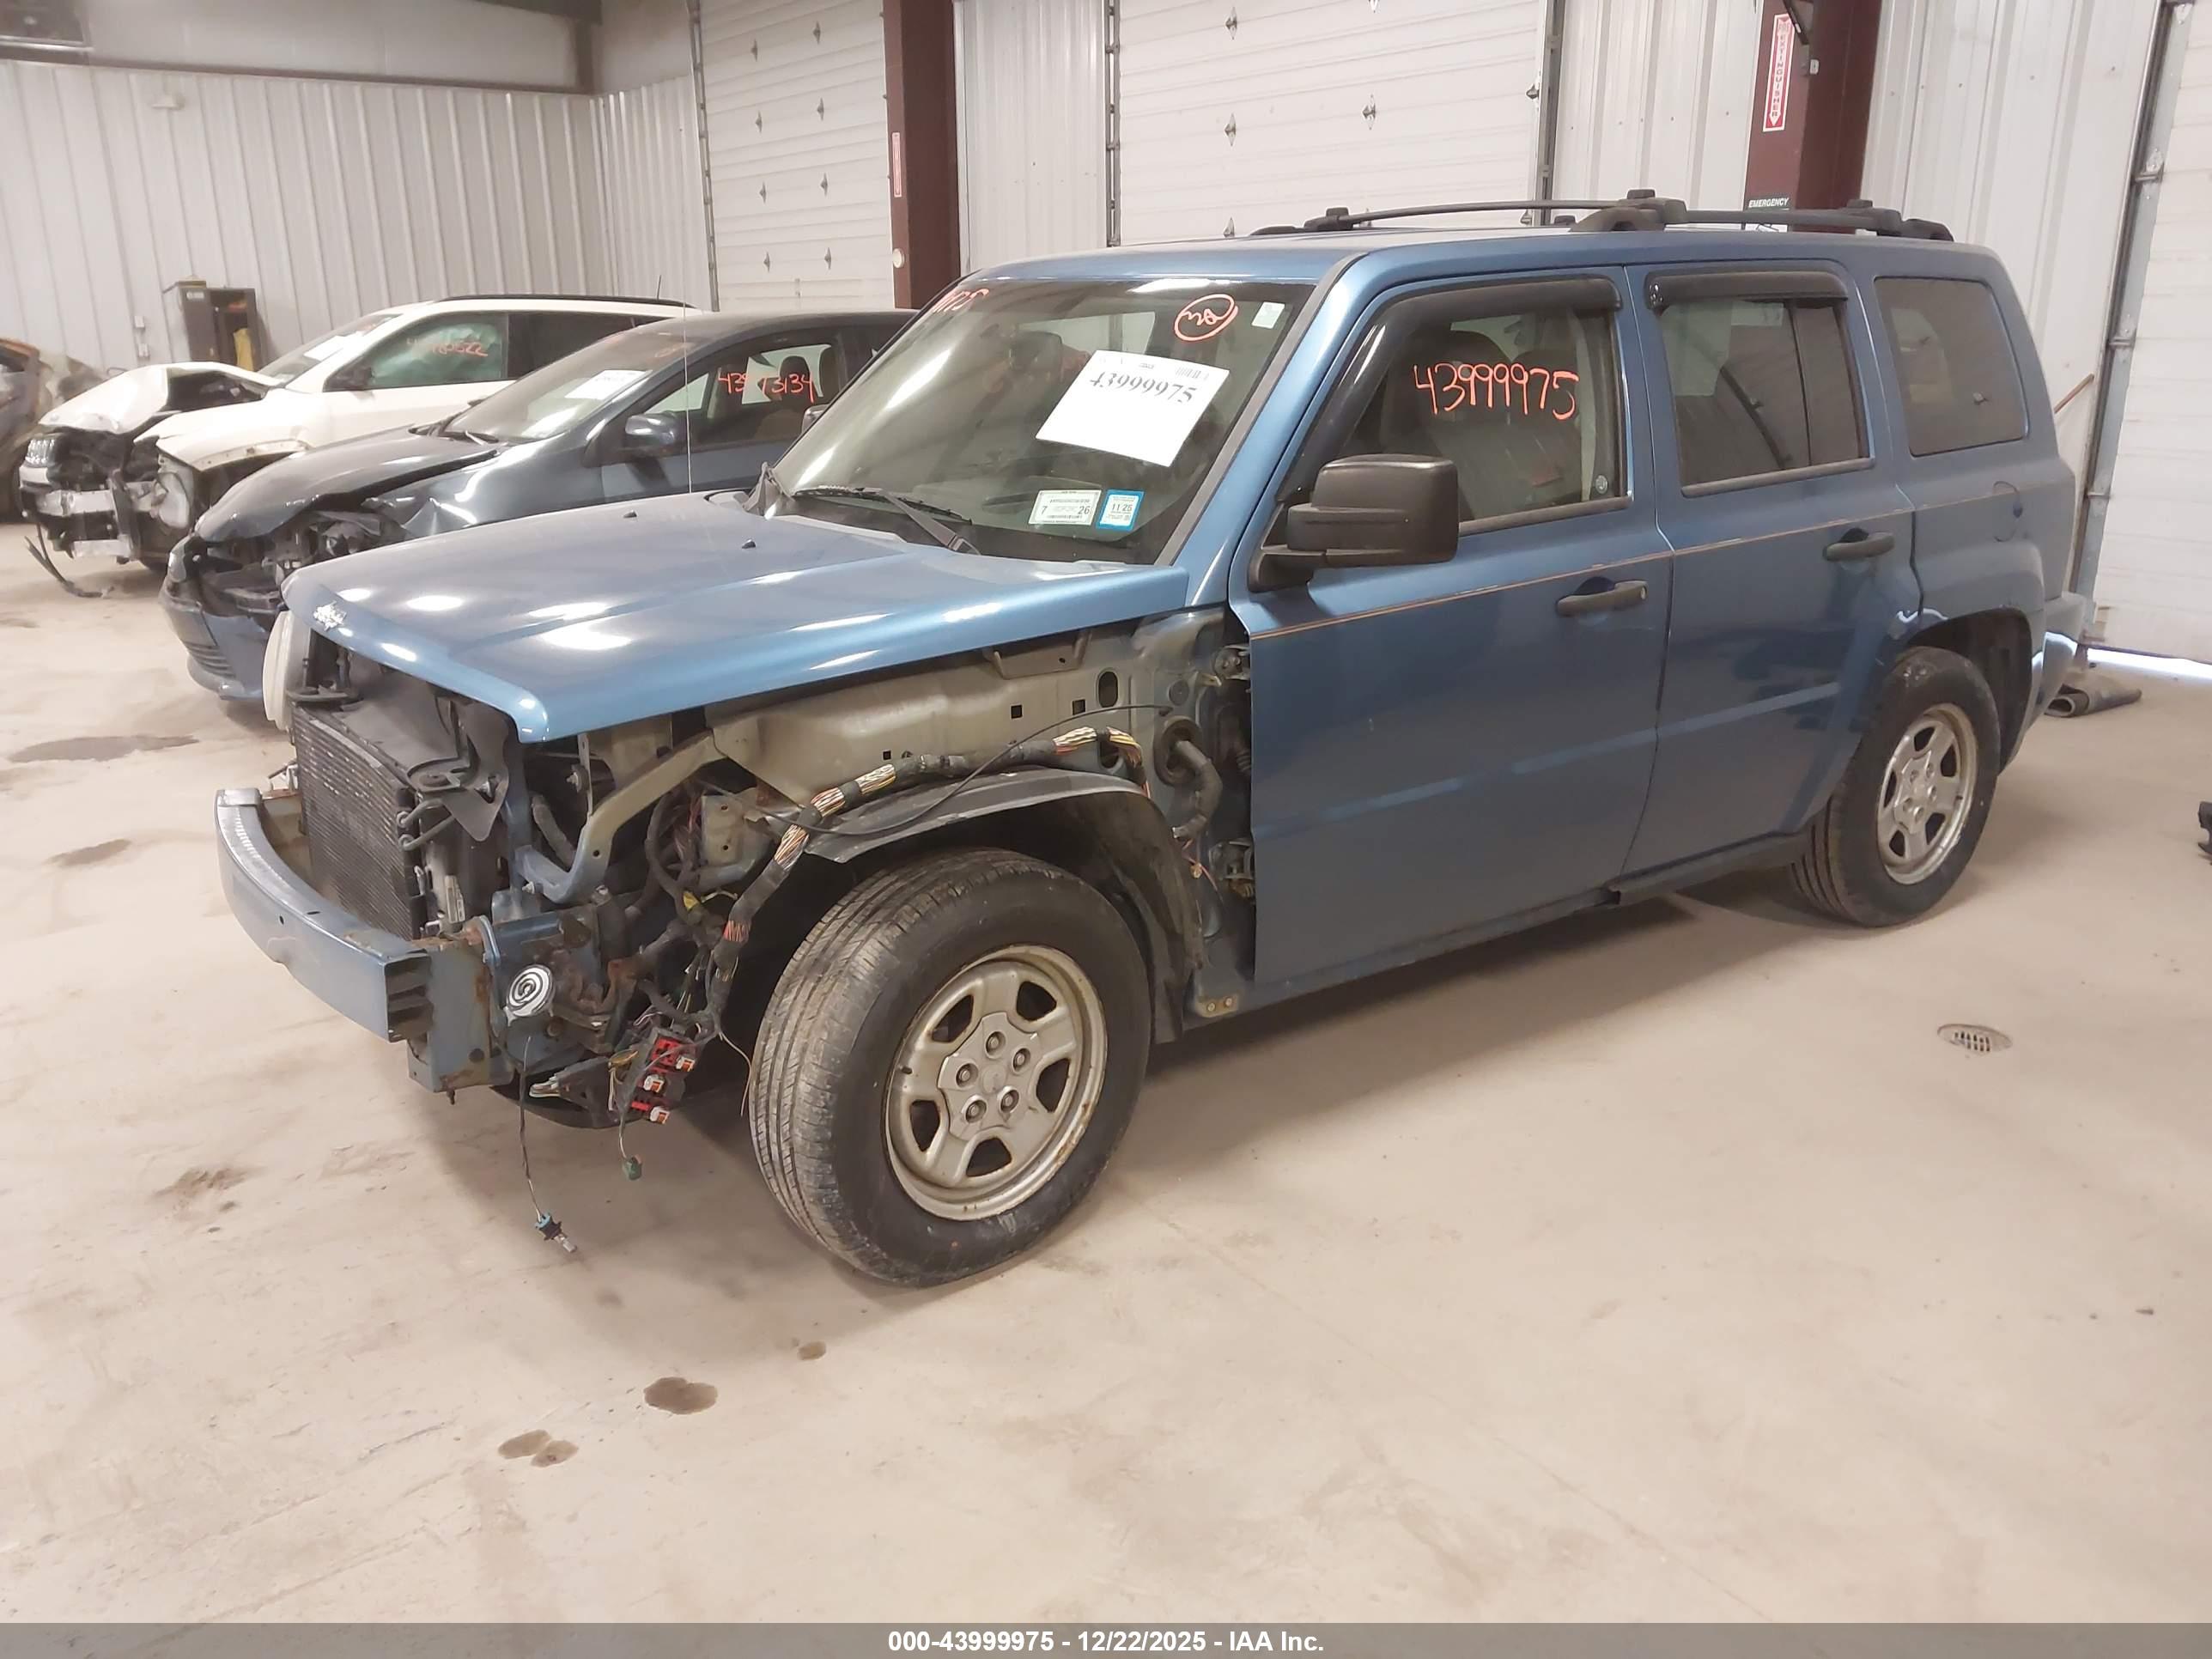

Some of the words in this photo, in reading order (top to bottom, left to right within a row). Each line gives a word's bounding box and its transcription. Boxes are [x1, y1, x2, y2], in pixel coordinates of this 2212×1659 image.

[1748, 198, 1790, 208] EMERGENCY
[1089, 371, 1197, 404] 43999975
[1413, 362, 1580, 421] 43999975
[1078, 505, 1091, 515] 26
